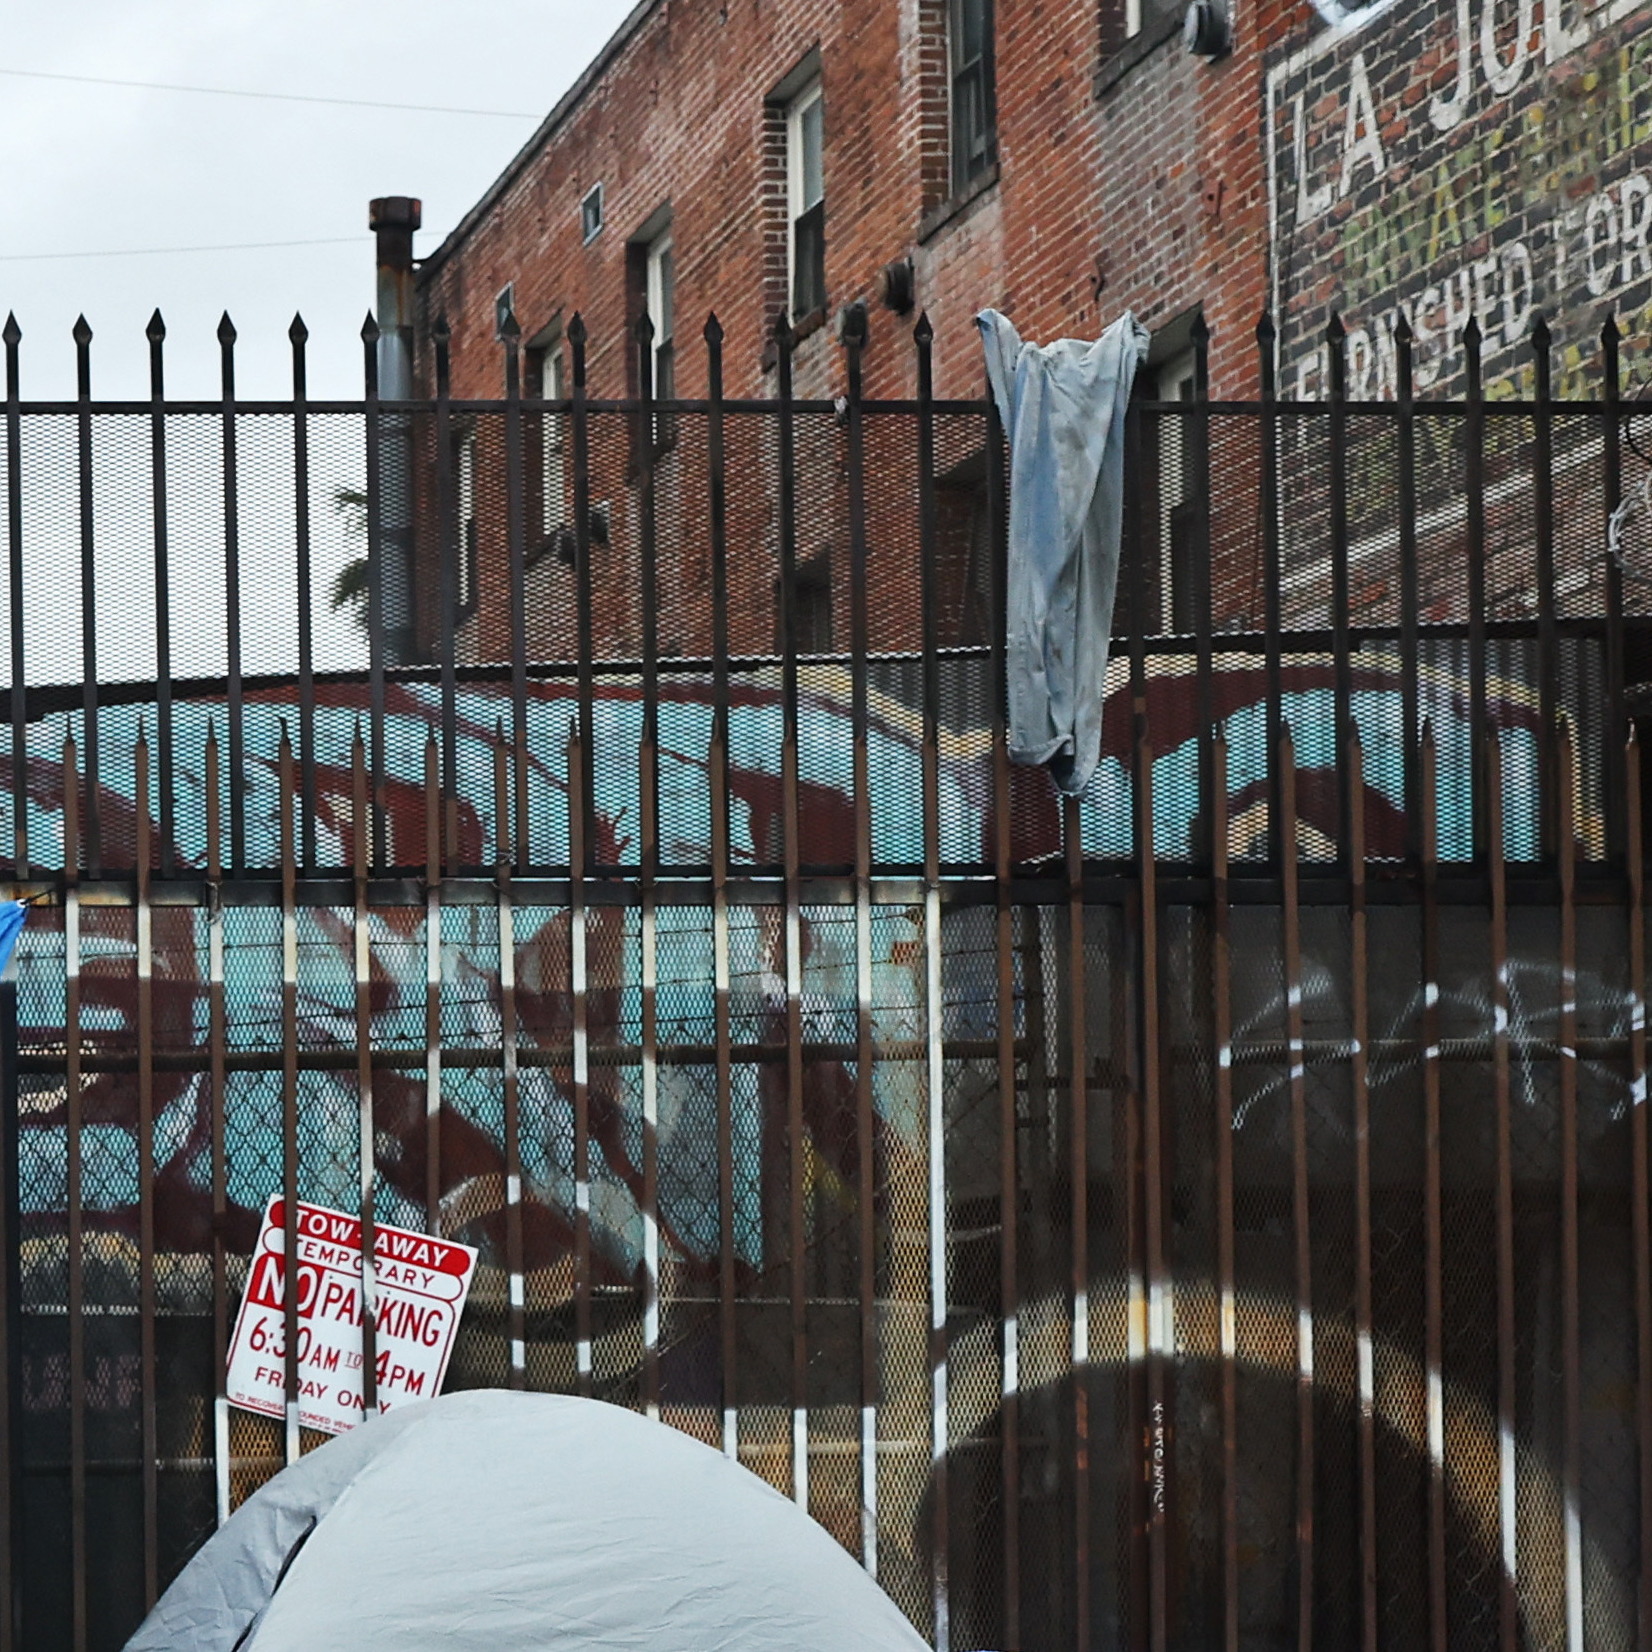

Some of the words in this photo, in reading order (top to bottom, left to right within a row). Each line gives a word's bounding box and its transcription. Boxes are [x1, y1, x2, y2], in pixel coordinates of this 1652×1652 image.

[1294, 52, 1386, 225] LA
[1295, 242, 1534, 447] FRNSHED
[257, 1255, 319, 1314] NO
[297, 1239, 435, 1290] EMPORARY
[337, 1389, 391, 1416] ONY
